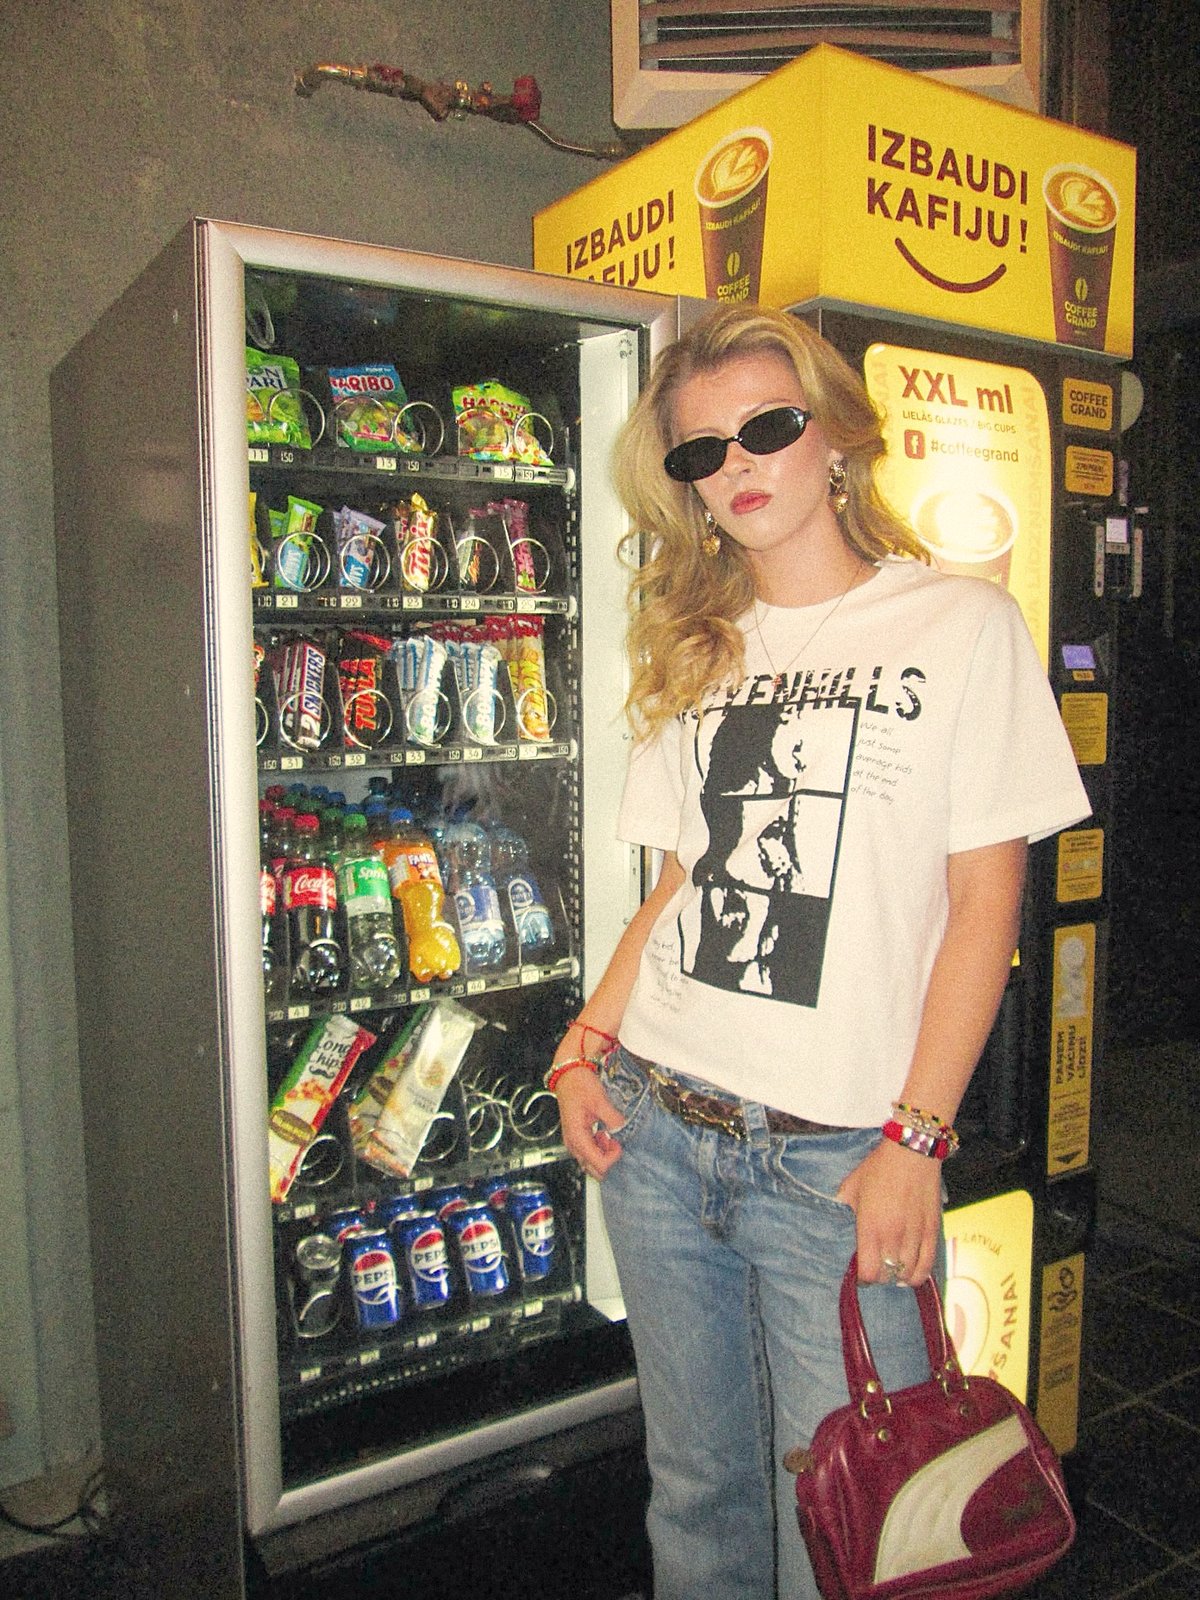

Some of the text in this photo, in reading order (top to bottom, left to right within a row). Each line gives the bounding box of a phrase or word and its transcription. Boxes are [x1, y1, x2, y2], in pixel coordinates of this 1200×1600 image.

[867, 124, 1028, 206] IZBAUDI
[867, 177, 1028, 254] KAFIJU!
[566, 189, 674, 274] IZBAUDI
[588, 235, 675, 288] FIJU!
[717, 273, 750, 296] COFFEE
[1064, 301, 1098, 318] COFFEE
[1066, 313, 1097, 329] GRAND
[898, 365, 1014, 414] XXL ml
[1069, 390, 1109, 407] COFFEE
[1070, 403, 1107, 419] GRAND
[994, 423, 1017, 434] CUPS
[930, 438, 1019, 462] #coffeegrand
[280, 596, 295, 606] 21
[407, 597, 420, 607] 23
[464, 600, 477, 609] 24
[303, 648, 325, 715] SNICKERS
[355, 658, 377, 730] TUPLA
[860, 721, 895, 736] We all
[855, 738, 876, 748] just
[287, 758, 300, 767] 31
[410, 752, 422, 761] 33
[468, 750, 479, 759] 34
[855, 753, 893, 771] average
[853, 769, 864, 778] at
[866, 771, 880, 780] the
[850, 784, 863, 793] of
[863, 786, 877, 797] the
[293, 1007, 306, 1016] 41
[470, 981, 482, 990] 44
[461, 1238, 497, 1253] PEPS
[414, 1249, 447, 1264] PEP
[353, 1269, 391, 1286] PEPS
